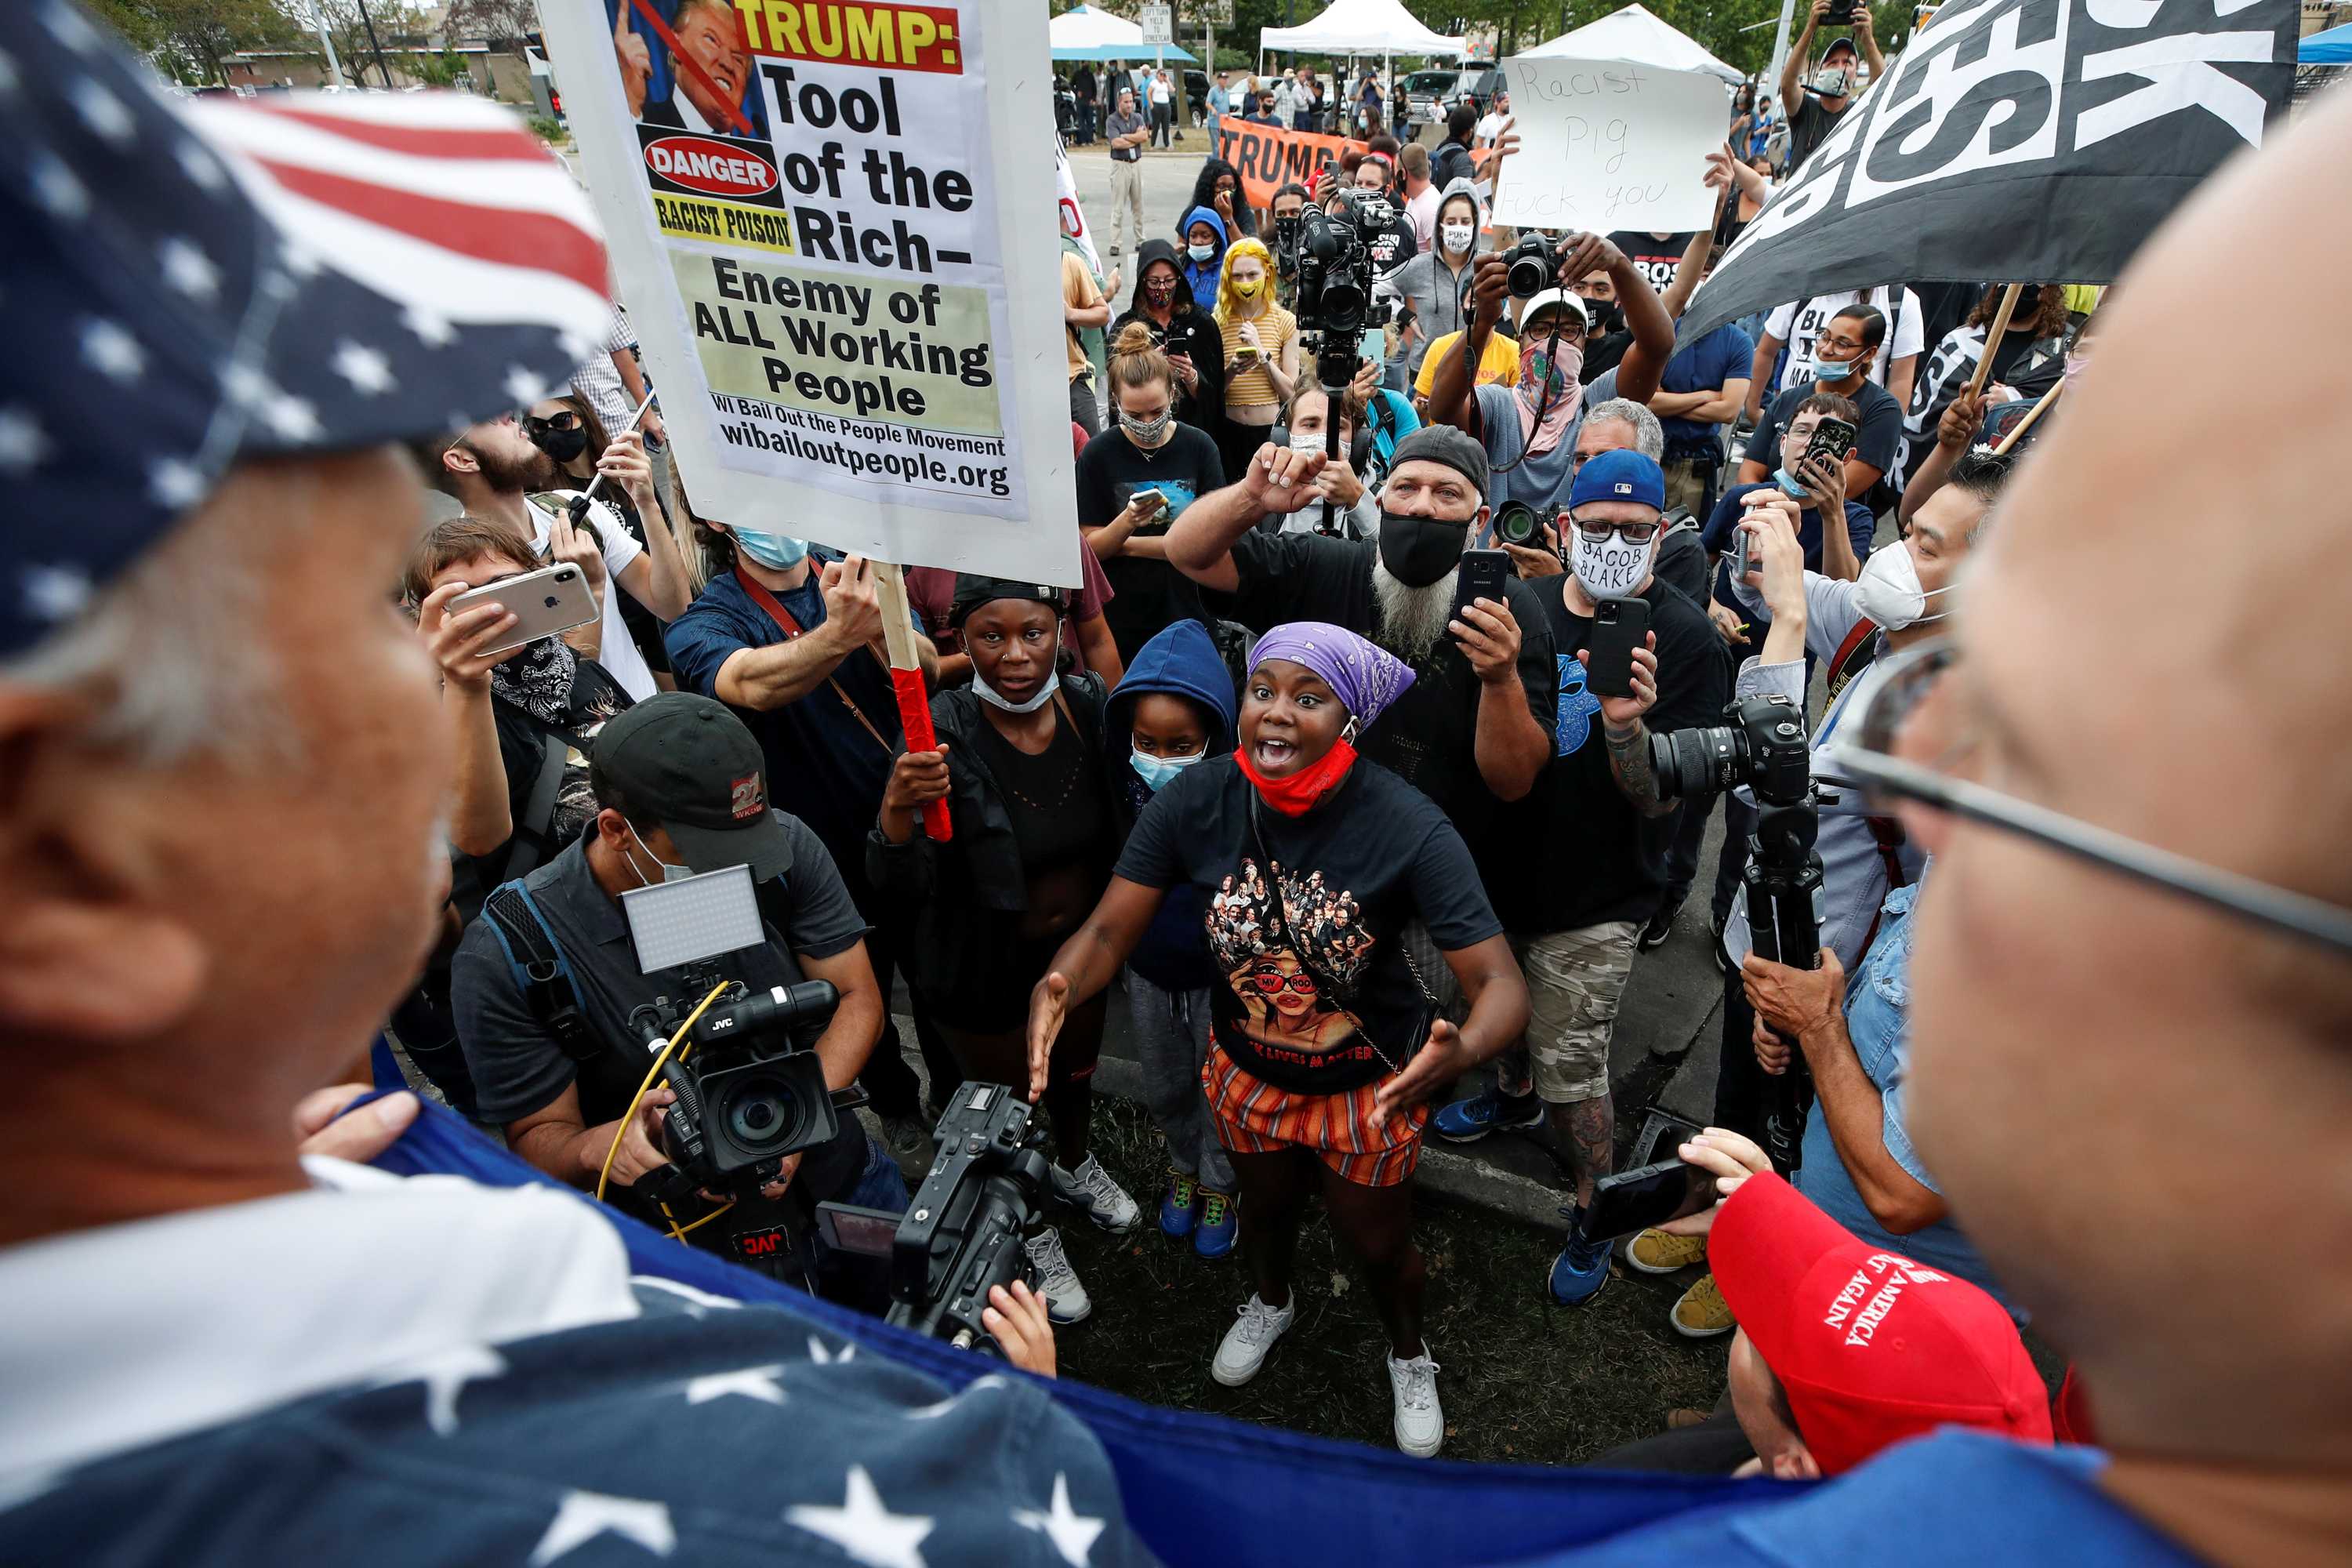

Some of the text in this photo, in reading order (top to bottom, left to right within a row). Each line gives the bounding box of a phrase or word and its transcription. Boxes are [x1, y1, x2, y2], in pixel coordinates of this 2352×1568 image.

[735, 0, 956, 66] TRUMP:
[761, 64, 902, 136] Tool
[652, 147, 769, 188] DANGER
[784, 141, 974, 212] of the
[655, 198, 792, 248] RACIST POISON
[711, 256, 941, 327] Enemy of
[695, 302, 993, 387] ALL Working
[763, 357, 927, 416] People
[711, 394, 1007, 456] WI Bail Out the People Movement
[720, 421, 1010, 497] wibailoutpeople.org
[1581, 560, 1637, 589] BLAKE
[1583, 542, 1642, 567] JACOB
[1292, 978, 1313, 988] ROO
[712, 1018, 733, 1031] JVC
[743, 1233, 782, 1254] JVC
[1824, 1269, 1872, 1330] AGAIN
[1844, 1269, 1908, 1347] AMERICA
